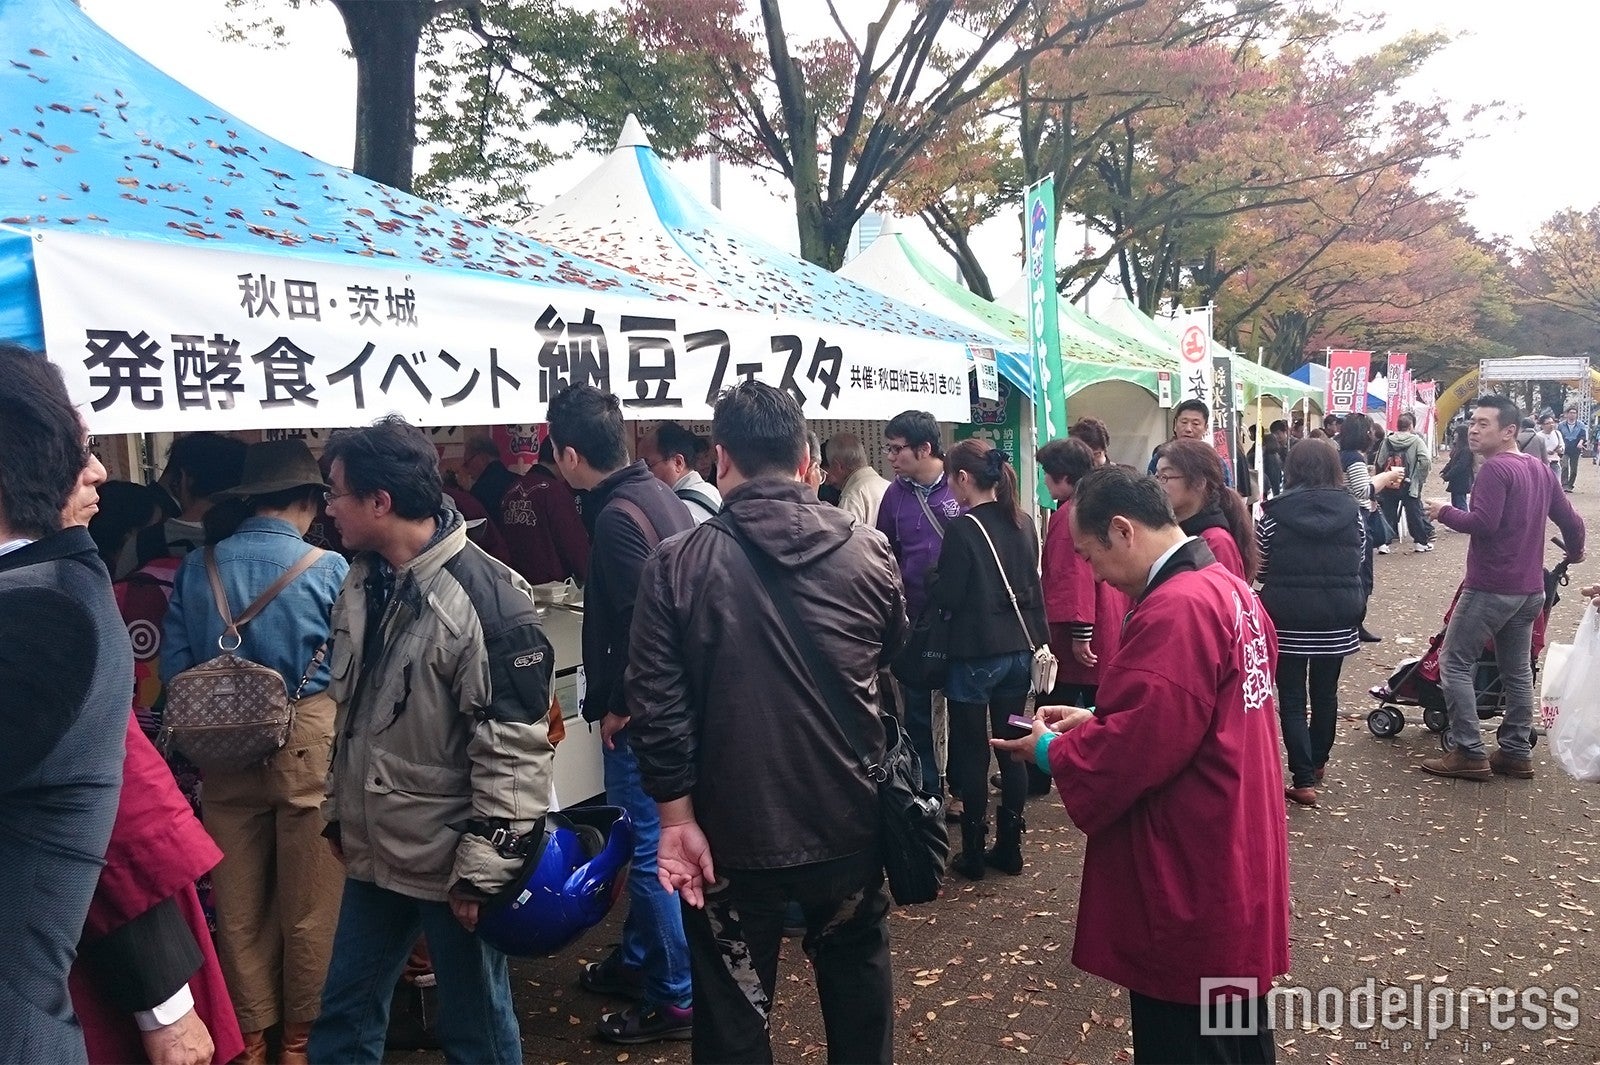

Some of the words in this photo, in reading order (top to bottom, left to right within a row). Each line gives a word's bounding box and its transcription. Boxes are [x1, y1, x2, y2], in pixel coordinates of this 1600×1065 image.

[237, 271, 419, 328] 秋田・茨城
[83, 328, 521, 413] 発酵食イベント
[533, 303, 843, 411] 納豆フェスタ
[1331, 366, 1357, 414] 納豆
